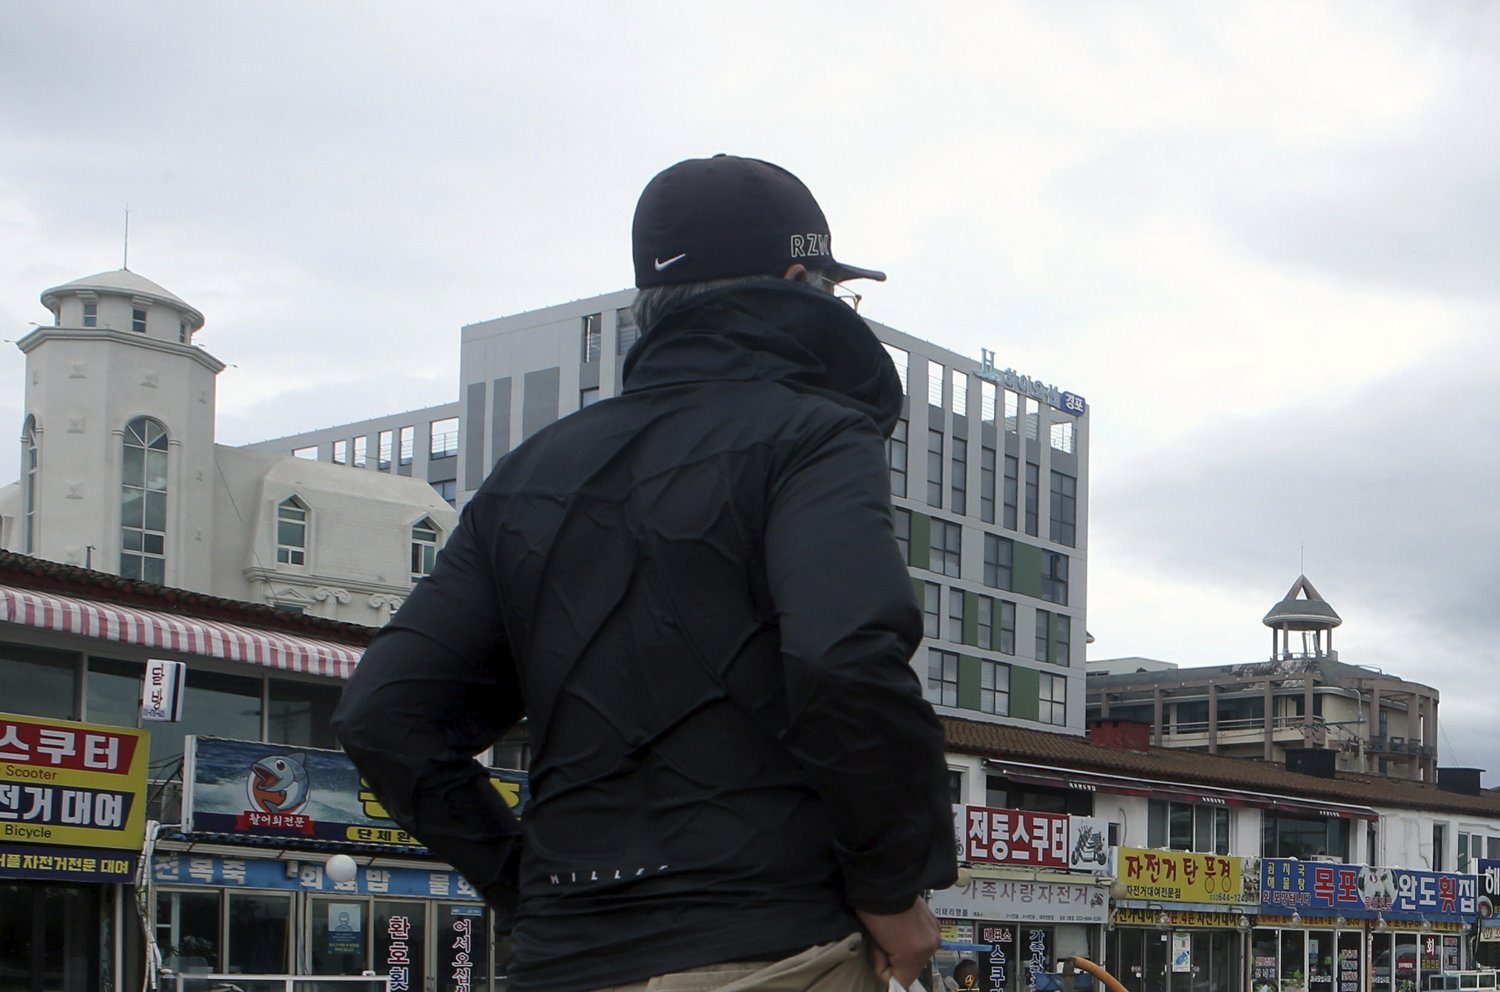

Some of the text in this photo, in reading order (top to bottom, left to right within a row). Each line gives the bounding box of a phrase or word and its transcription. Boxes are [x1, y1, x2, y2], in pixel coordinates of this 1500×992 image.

[0, 725, 119, 770] 스쿠터
[6, 765, 57, 780] Scooter
[61, 790, 122, 827] 대여
[5, 824, 52, 839] Bicycle
[969, 810, 1068, 861] 전동스쿠터
[101, 859, 129, 874] 대여
[301, 866, 391, 893] 회밥
[1125, 854, 1232, 893] 자전거 탄 풍경
[962, 879, 1088, 905] 가족사랑자전거
[1127, 885, 1181, 899] 자전거대여전문점
[1314, 867, 1475, 913] 목포 완도횟집
[1426, 937, 1435, 956] 회
